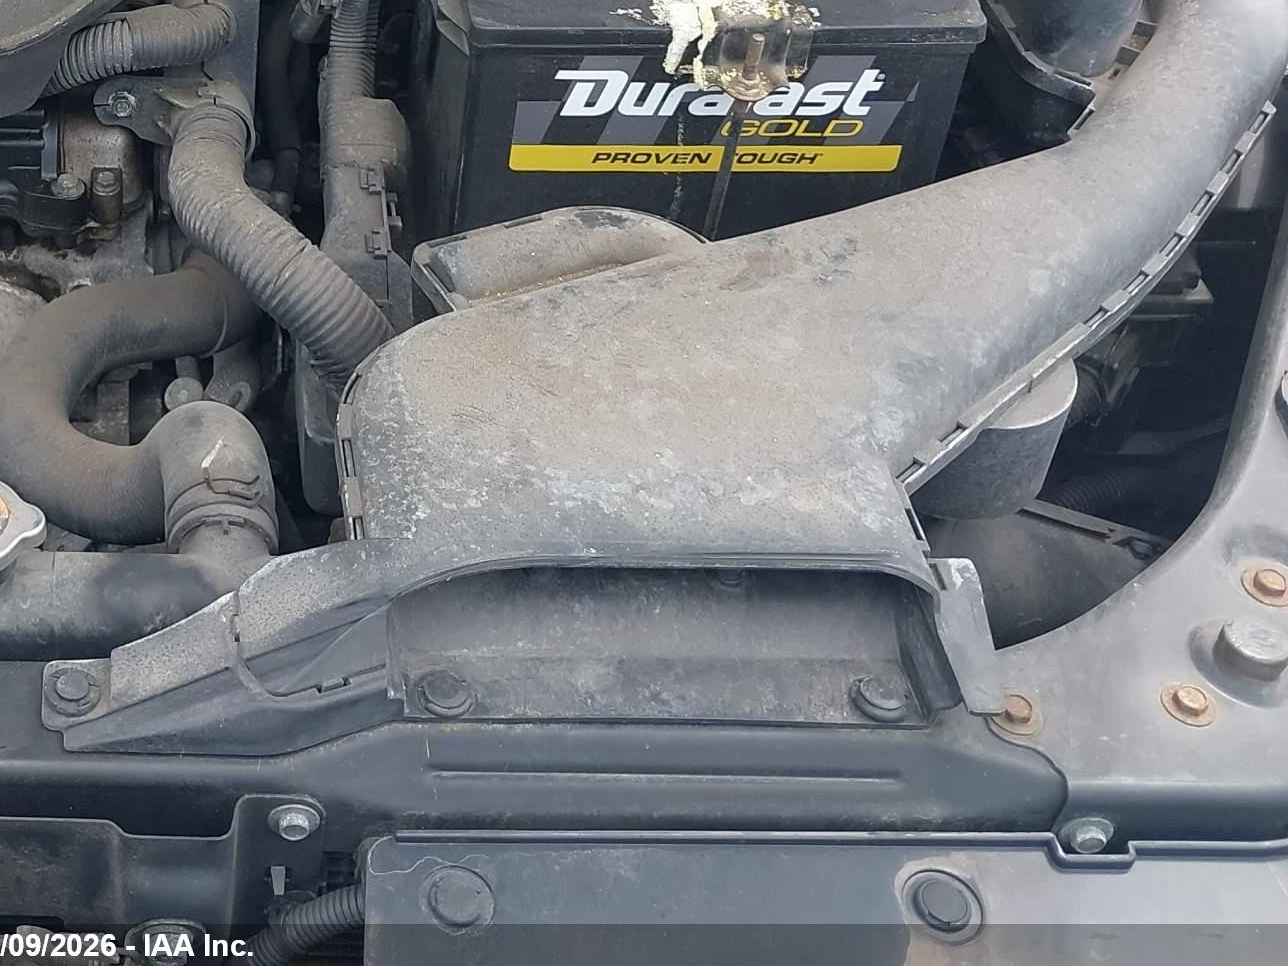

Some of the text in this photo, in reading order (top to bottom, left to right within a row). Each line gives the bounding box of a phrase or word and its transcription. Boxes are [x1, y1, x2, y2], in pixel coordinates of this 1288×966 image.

[554, 69, 883, 117] Duraast
[591, 152, 820, 165] PROVEN OUGH
